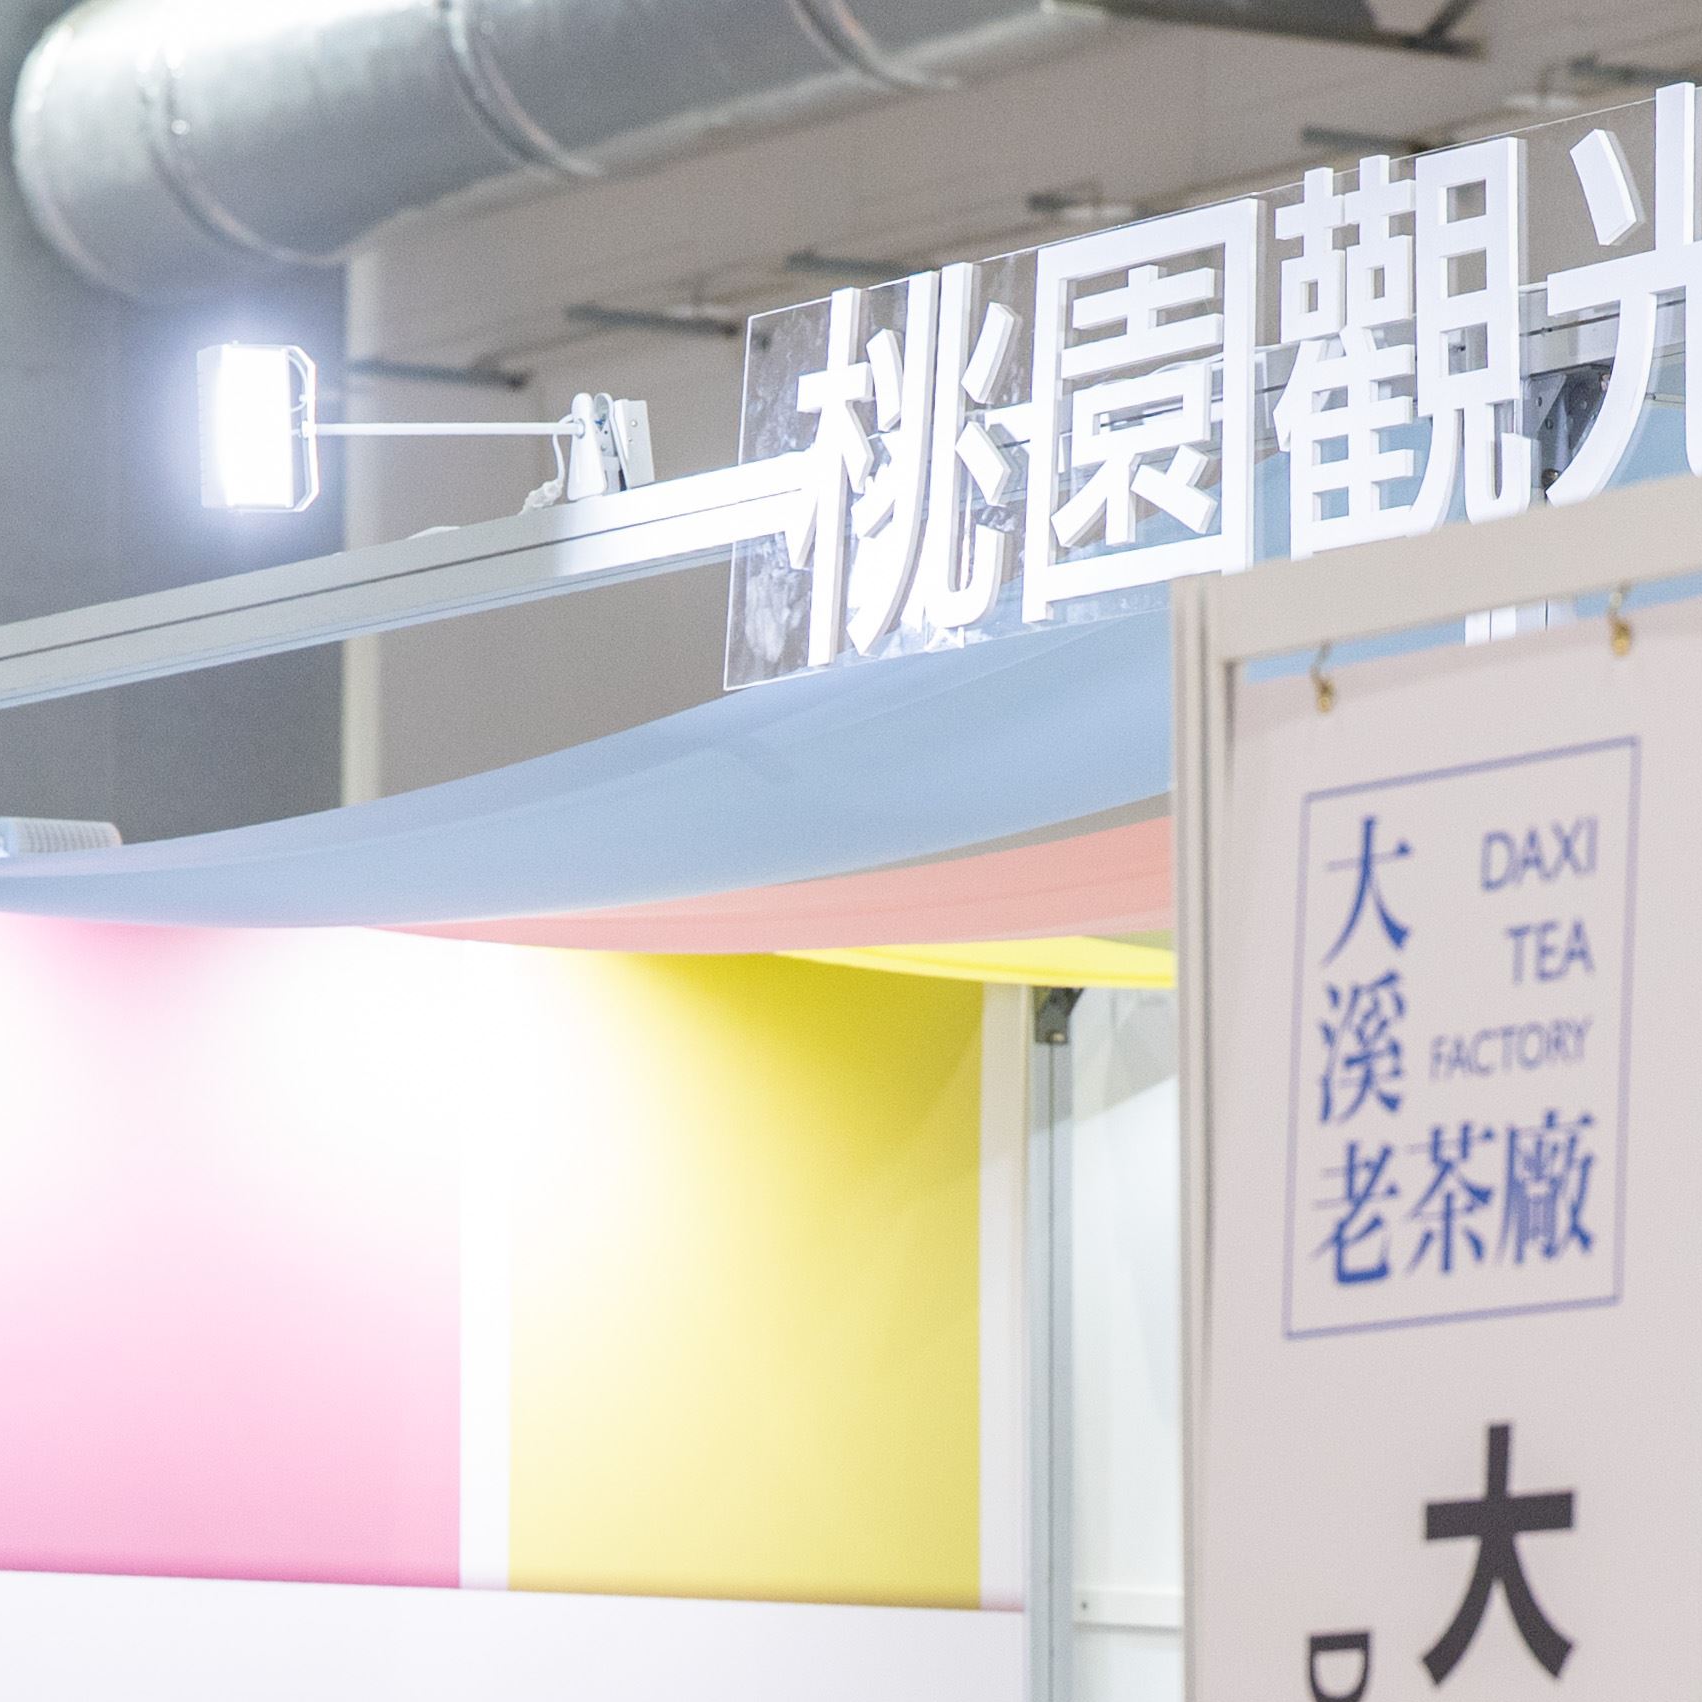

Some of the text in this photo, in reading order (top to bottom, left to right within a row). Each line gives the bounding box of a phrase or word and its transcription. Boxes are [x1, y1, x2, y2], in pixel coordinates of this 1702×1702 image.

[1479, 818, 1598, 892] DAXI
[1505, 919, 1595, 985] TEA
[1429, 1017, 1594, 1080] FACTORY
